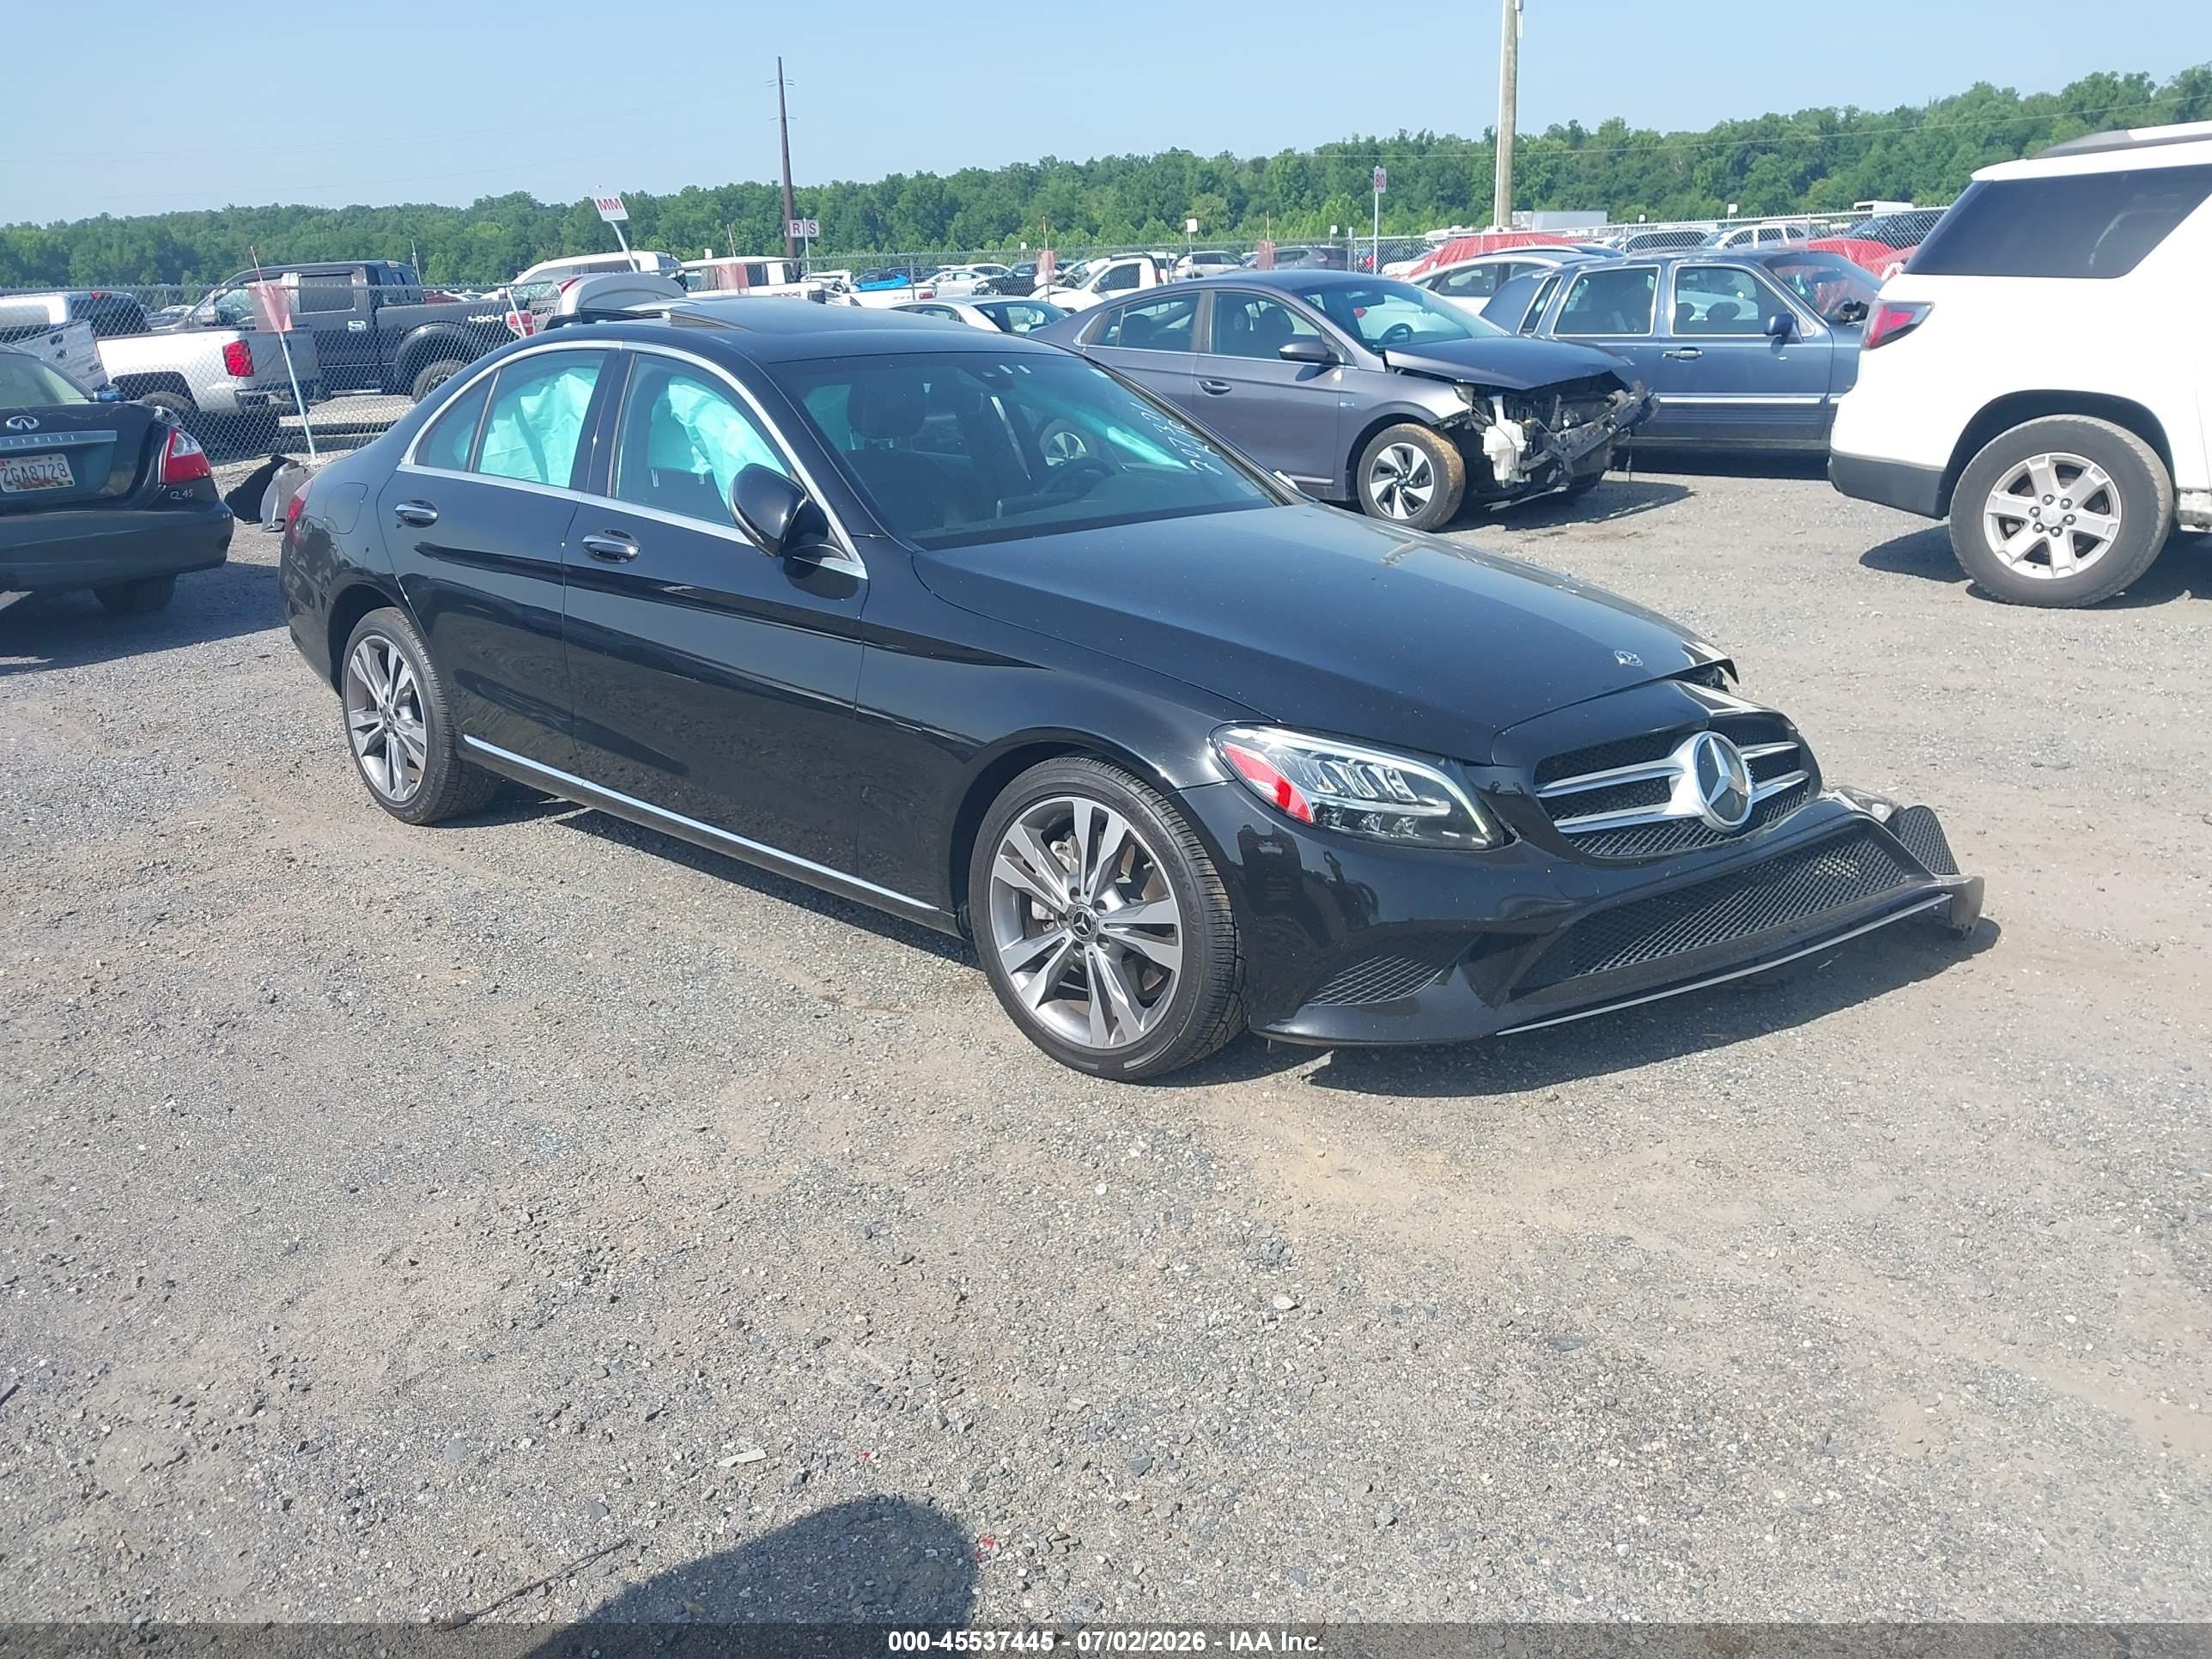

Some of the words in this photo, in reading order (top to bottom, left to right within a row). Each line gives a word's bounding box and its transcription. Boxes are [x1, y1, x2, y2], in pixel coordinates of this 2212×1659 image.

[596, 198, 623, 211] MM
[793, 222, 800, 234] R
[809, 222, 817, 234] S
